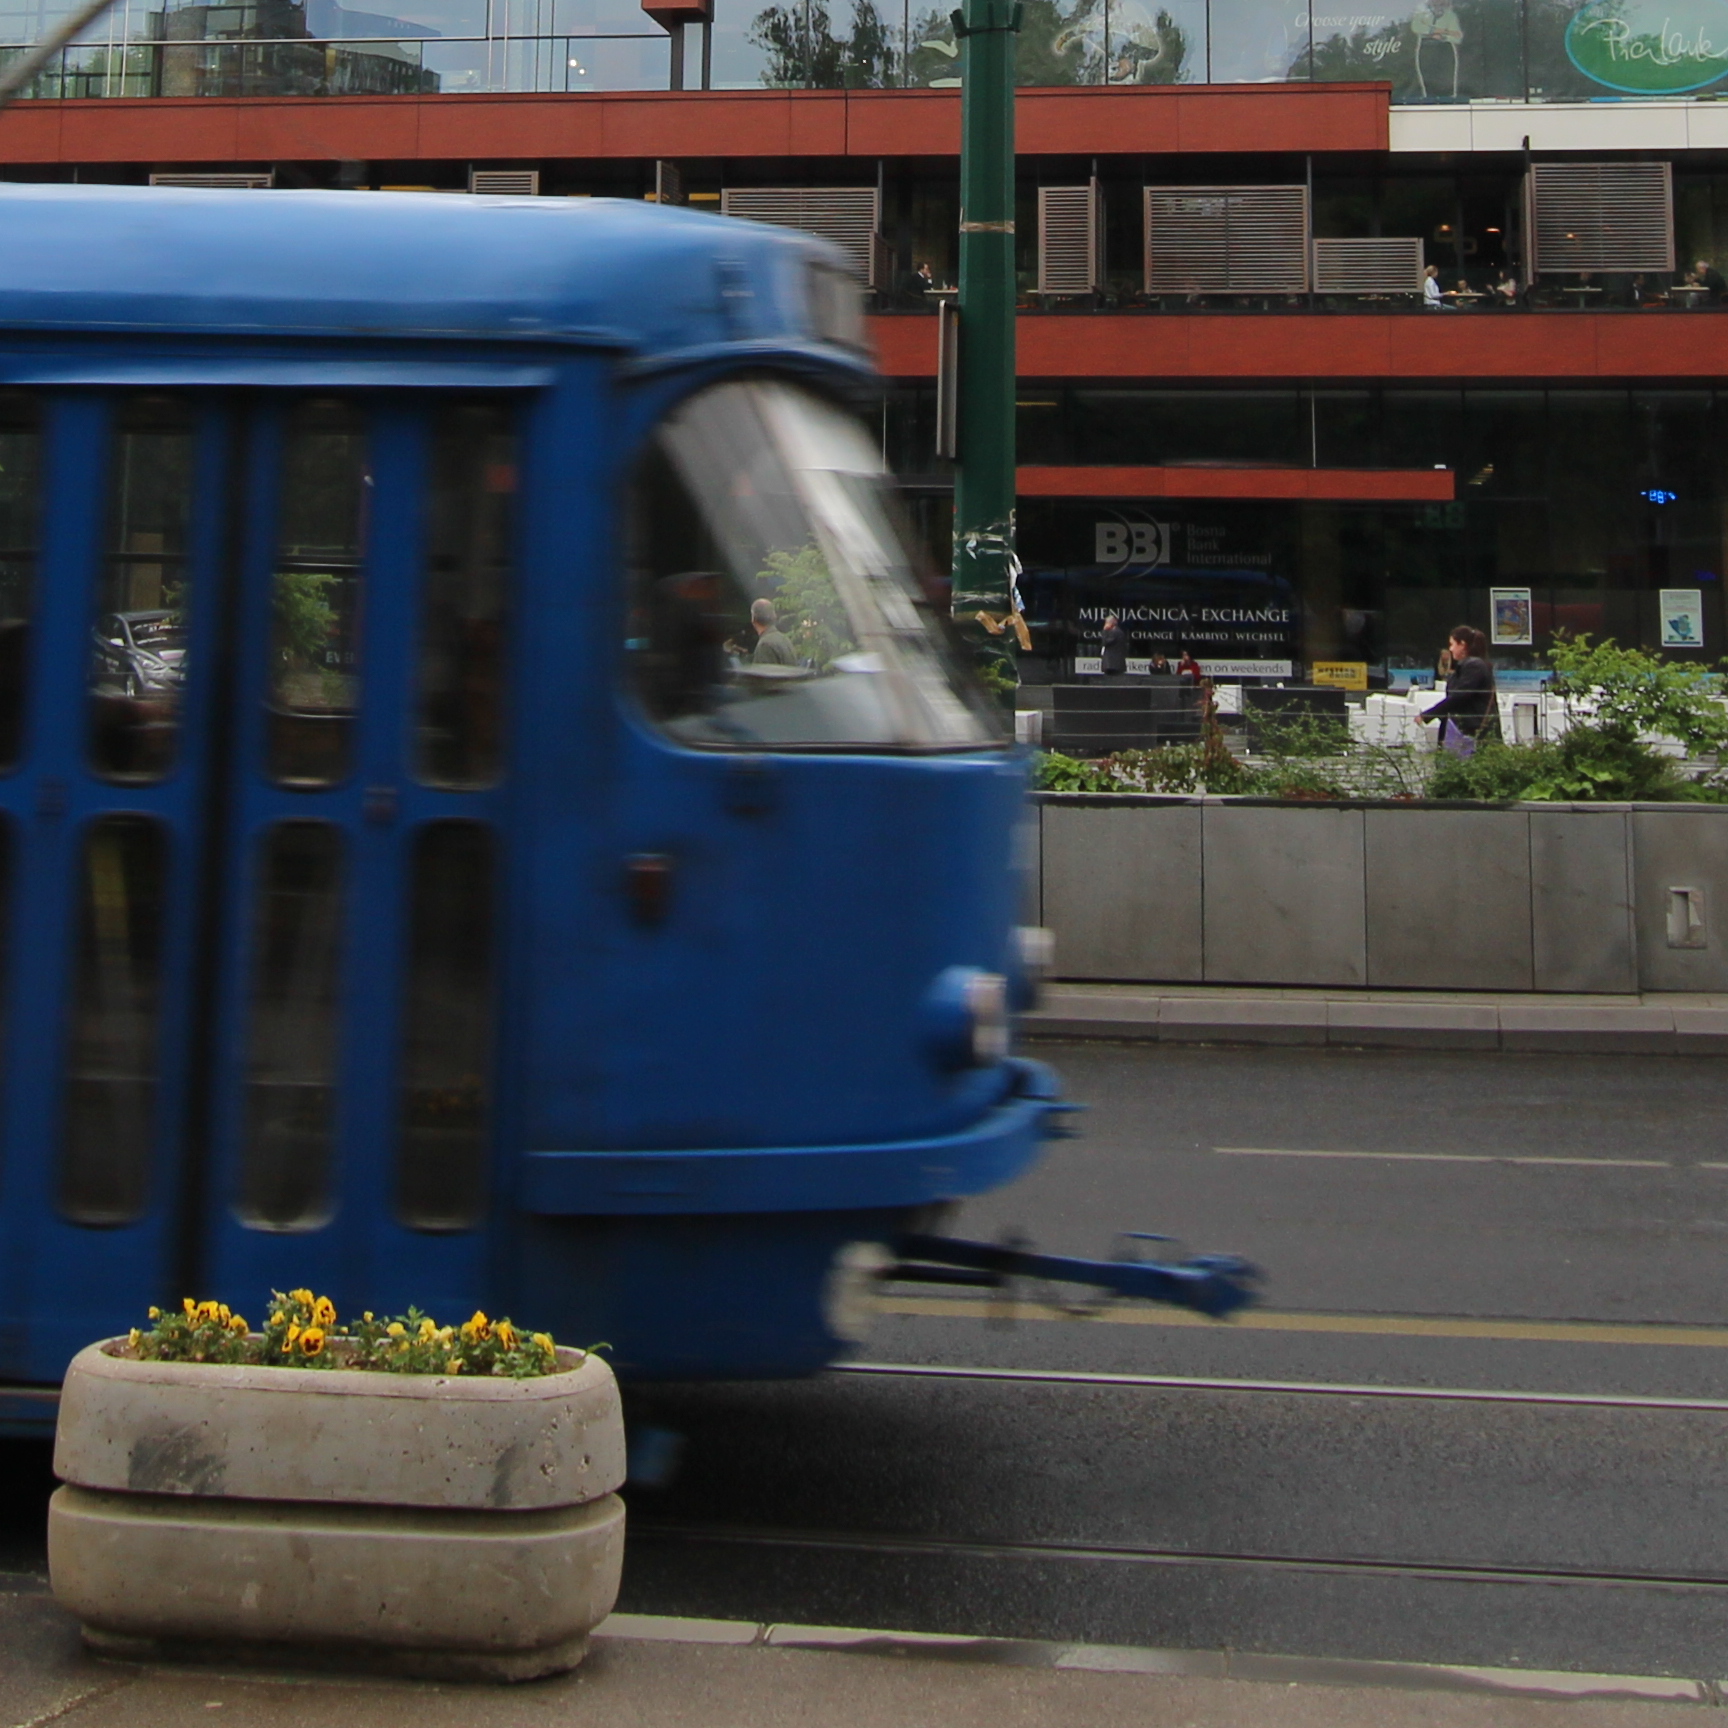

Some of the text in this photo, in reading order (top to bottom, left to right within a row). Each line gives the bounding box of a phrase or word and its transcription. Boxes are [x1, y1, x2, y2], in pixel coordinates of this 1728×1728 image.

[1362, 36, 1402, 63] style
[1186, 523, 1226, 537] Bosna
[1095, 522, 1171, 564] BBI
[1186, 537, 1220, 551] Bank
[1186, 552, 1272, 565] International
[1078, 605, 1189, 623] MJENJAČNICA
[1202, 608, 1290, 623] EXCHANGE
[1131, 630, 1174, 640] CHANGE
[1181, 631, 1229, 641] KAMBIYO
[1235, 632, 1286, 642] WECHSEL
[1214, 662, 1228, 673] on
[1229, 659, 1285, 673] weekends
